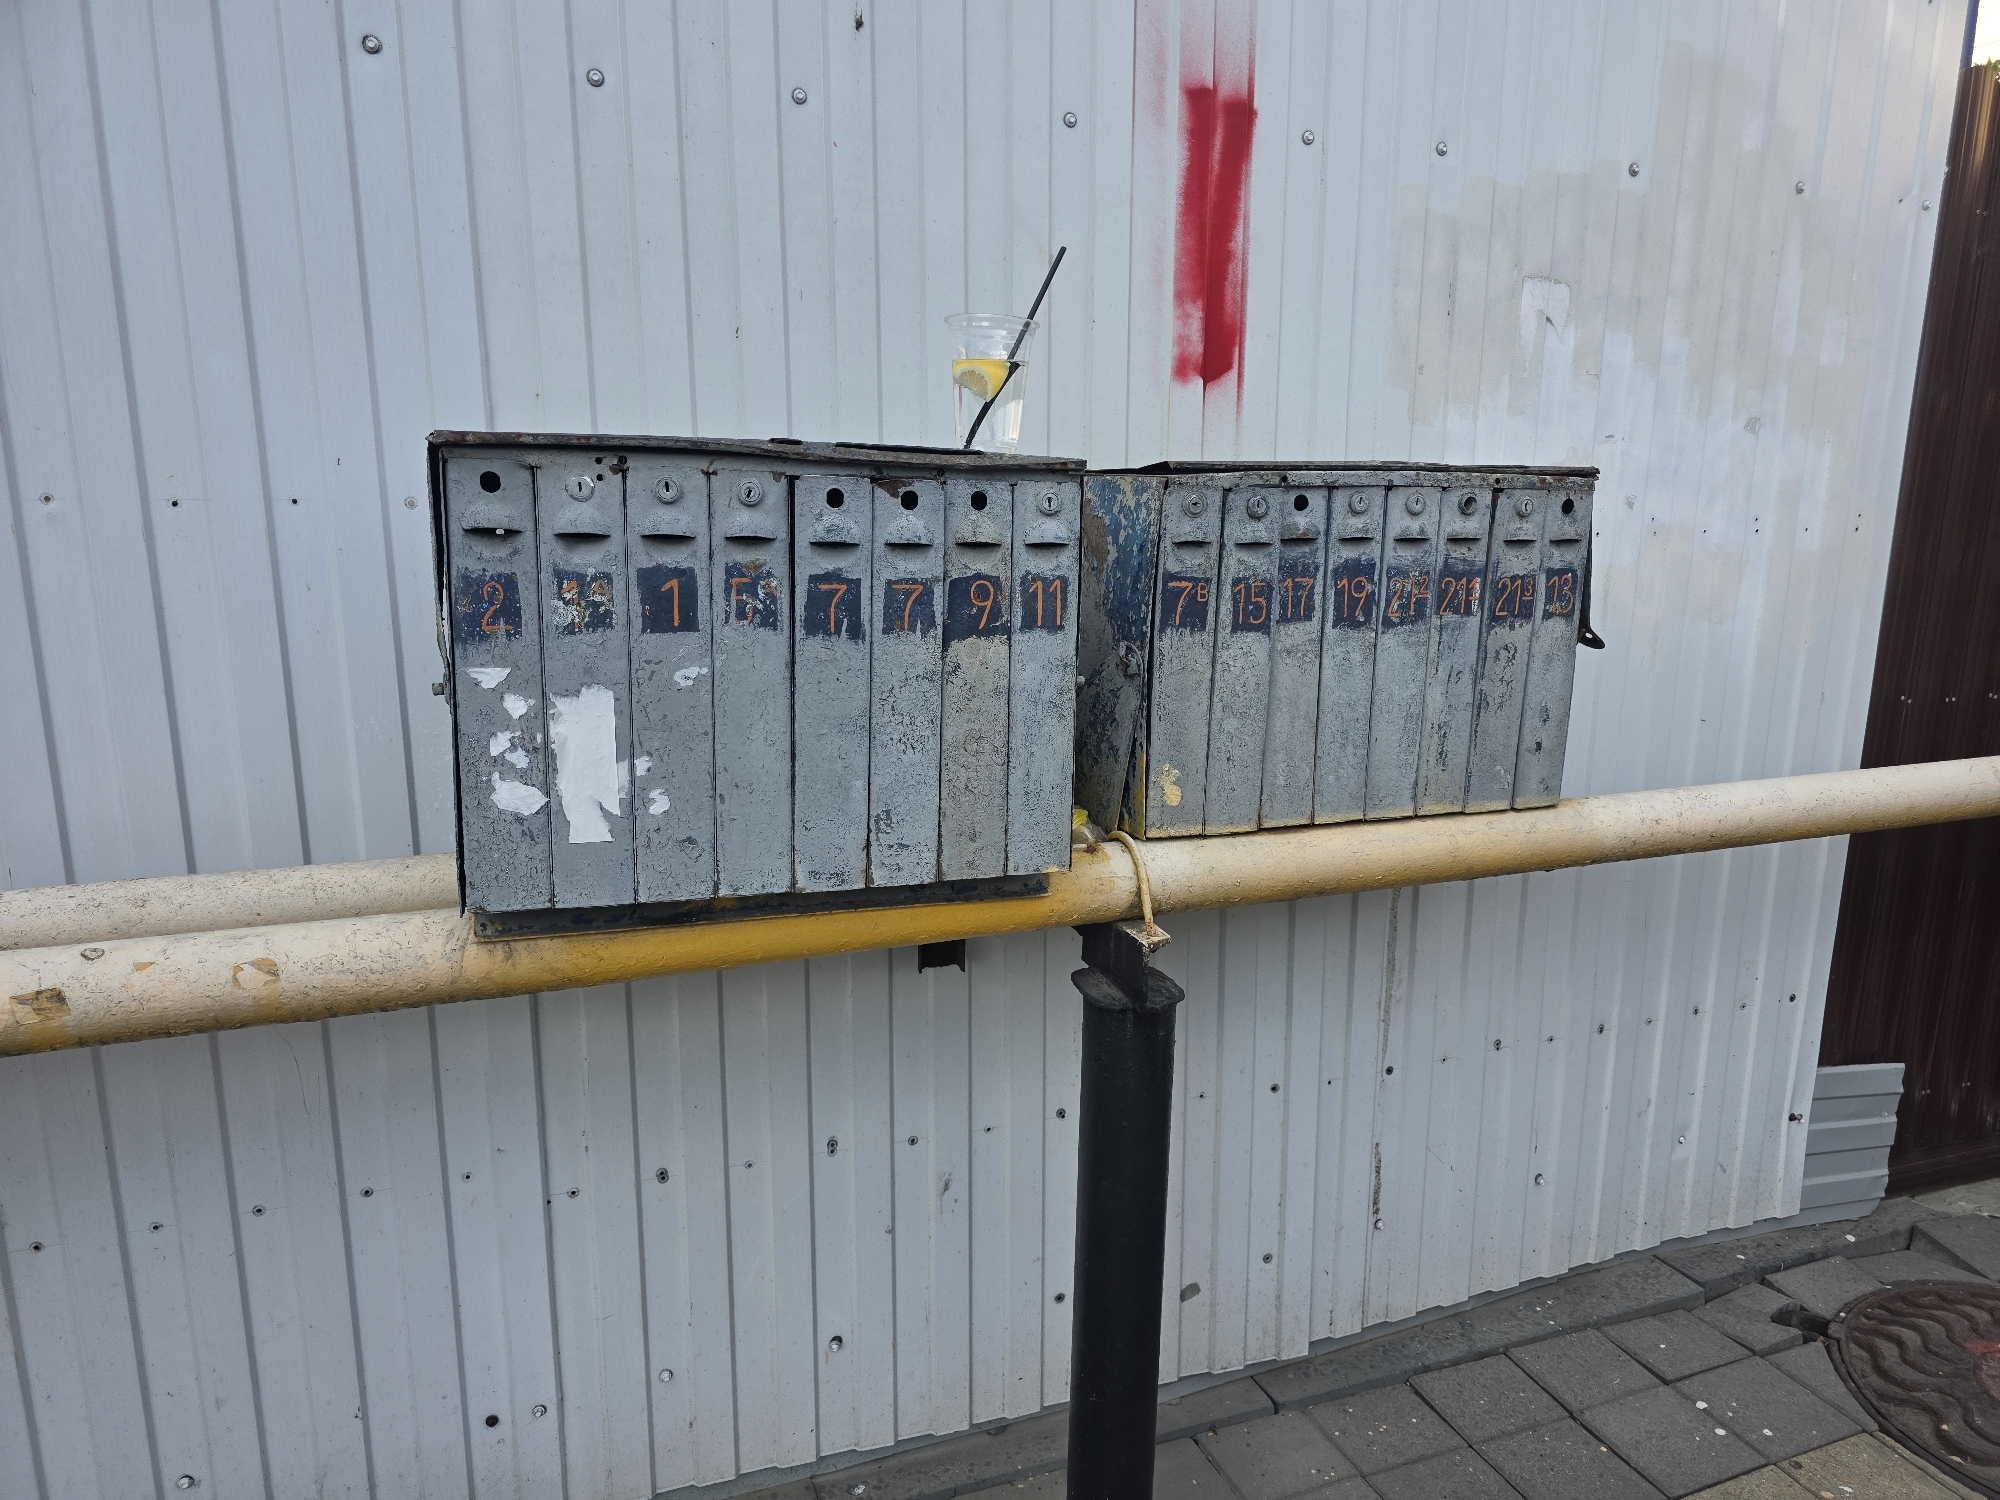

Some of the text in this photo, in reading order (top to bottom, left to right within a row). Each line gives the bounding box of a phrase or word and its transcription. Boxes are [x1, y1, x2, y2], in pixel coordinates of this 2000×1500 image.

[482, 581, 513, 630] 2
[660, 578, 680, 627] 1
[818, 583, 848, 633] 7
[892, 584, 924, 631] 7
[970, 579, 995, 629] 9
[1028, 579, 1062, 626] 11
[1233, 582, 1267, 625] 15
[1282, 577, 1315, 618] 17
[1337, 576, 1369, 617] 19
[1547, 574, 1574, 614] 13
